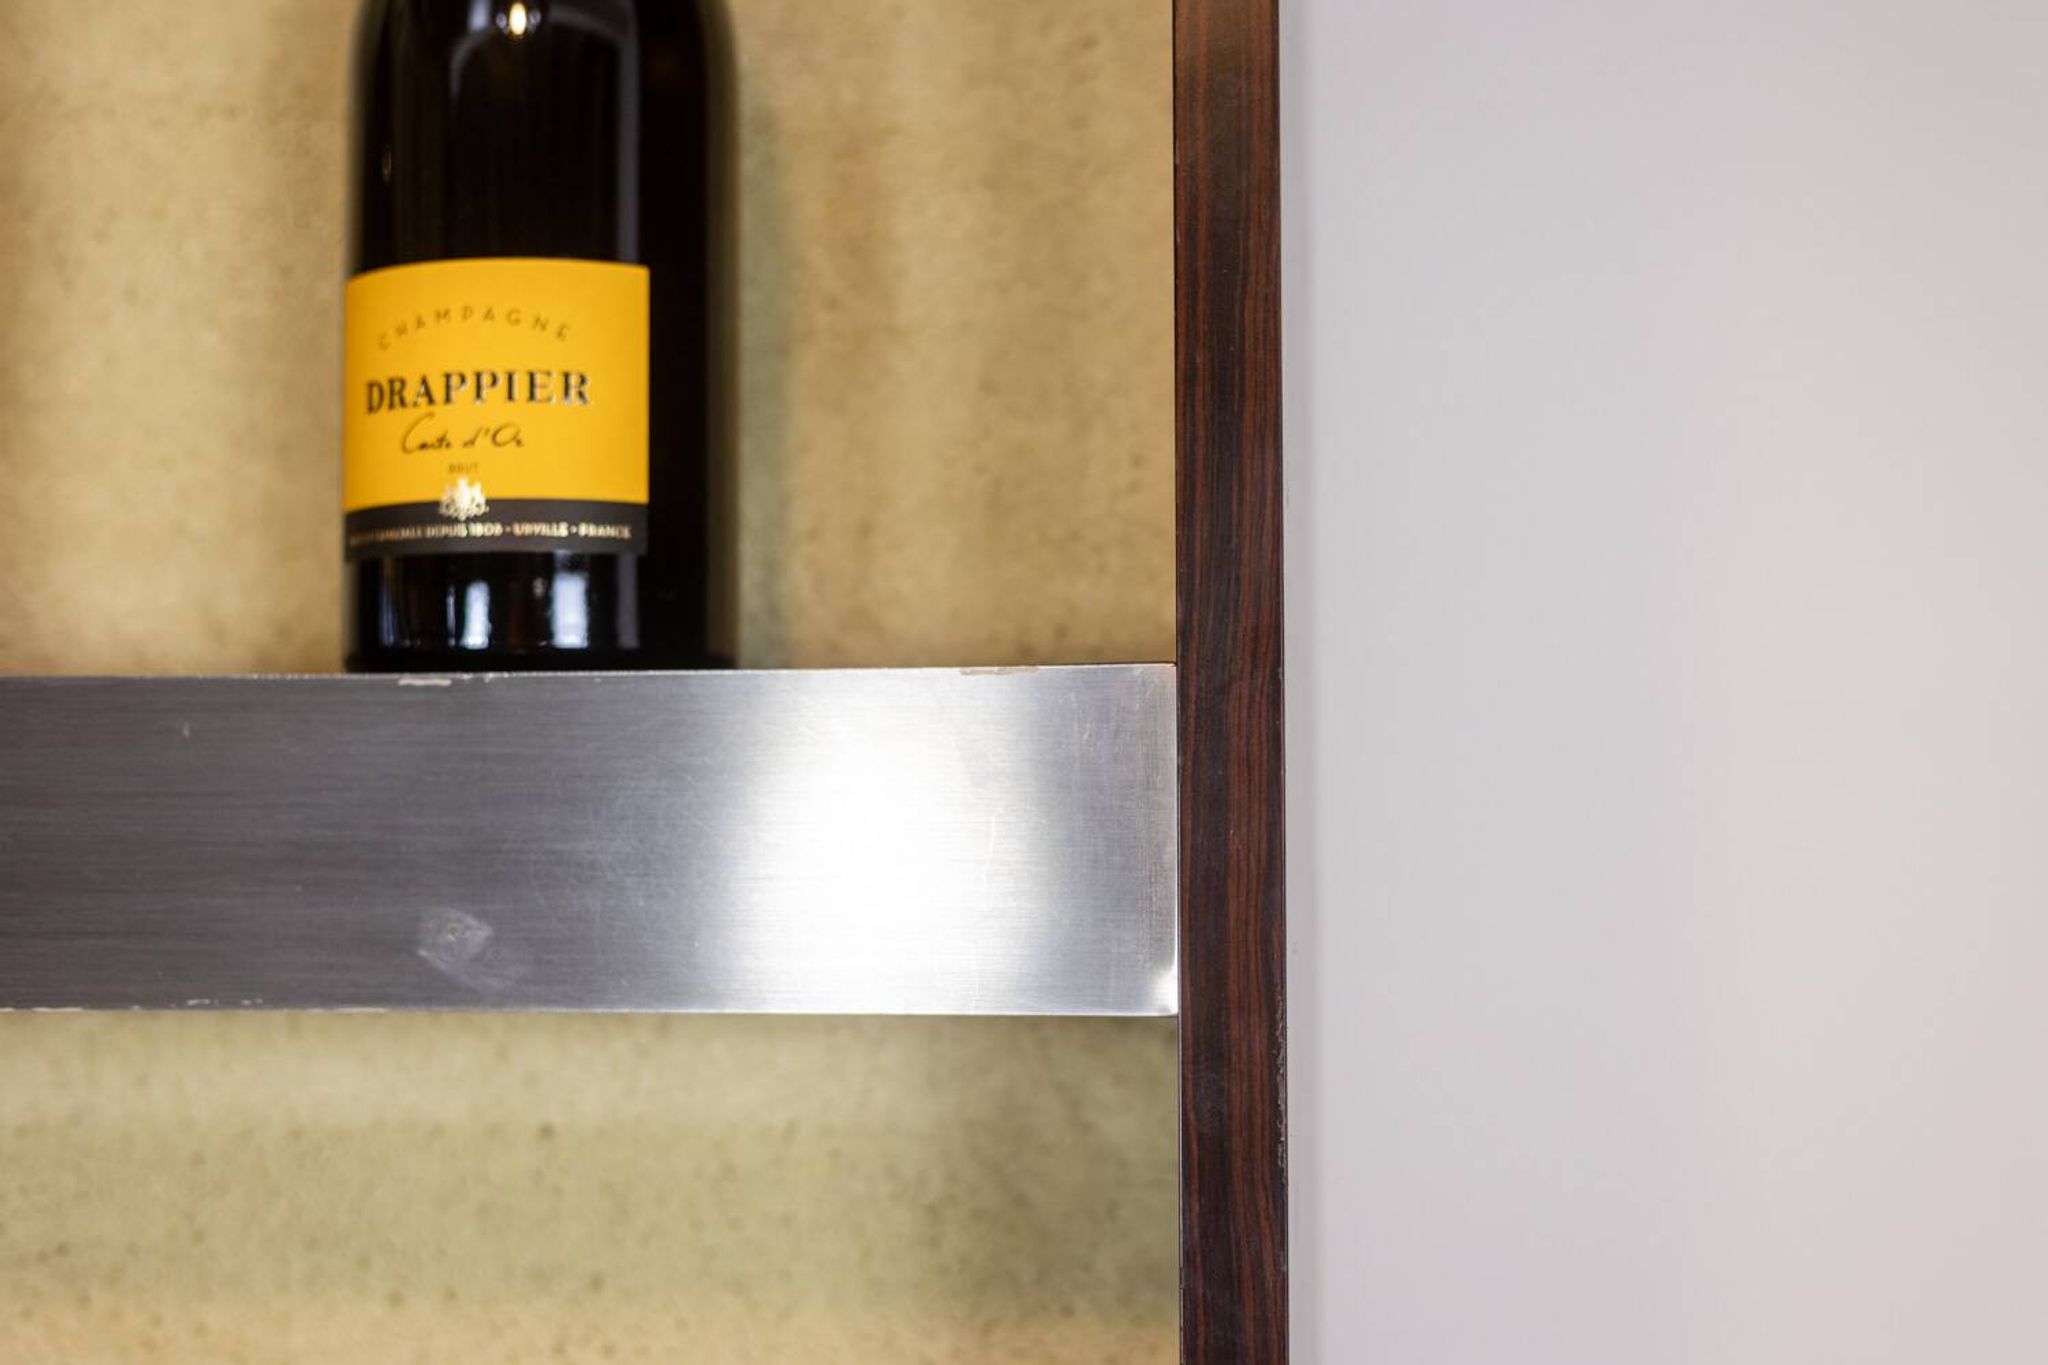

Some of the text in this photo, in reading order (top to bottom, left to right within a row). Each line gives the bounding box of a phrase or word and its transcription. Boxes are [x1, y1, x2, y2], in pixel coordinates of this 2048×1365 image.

[378, 305, 570, 350] CHAMPAGNE
[366, 371, 589, 414] DRAPPIER
[447, 462, 479, 474] BRUT
[578, 522, 632, 539] FRANCE
